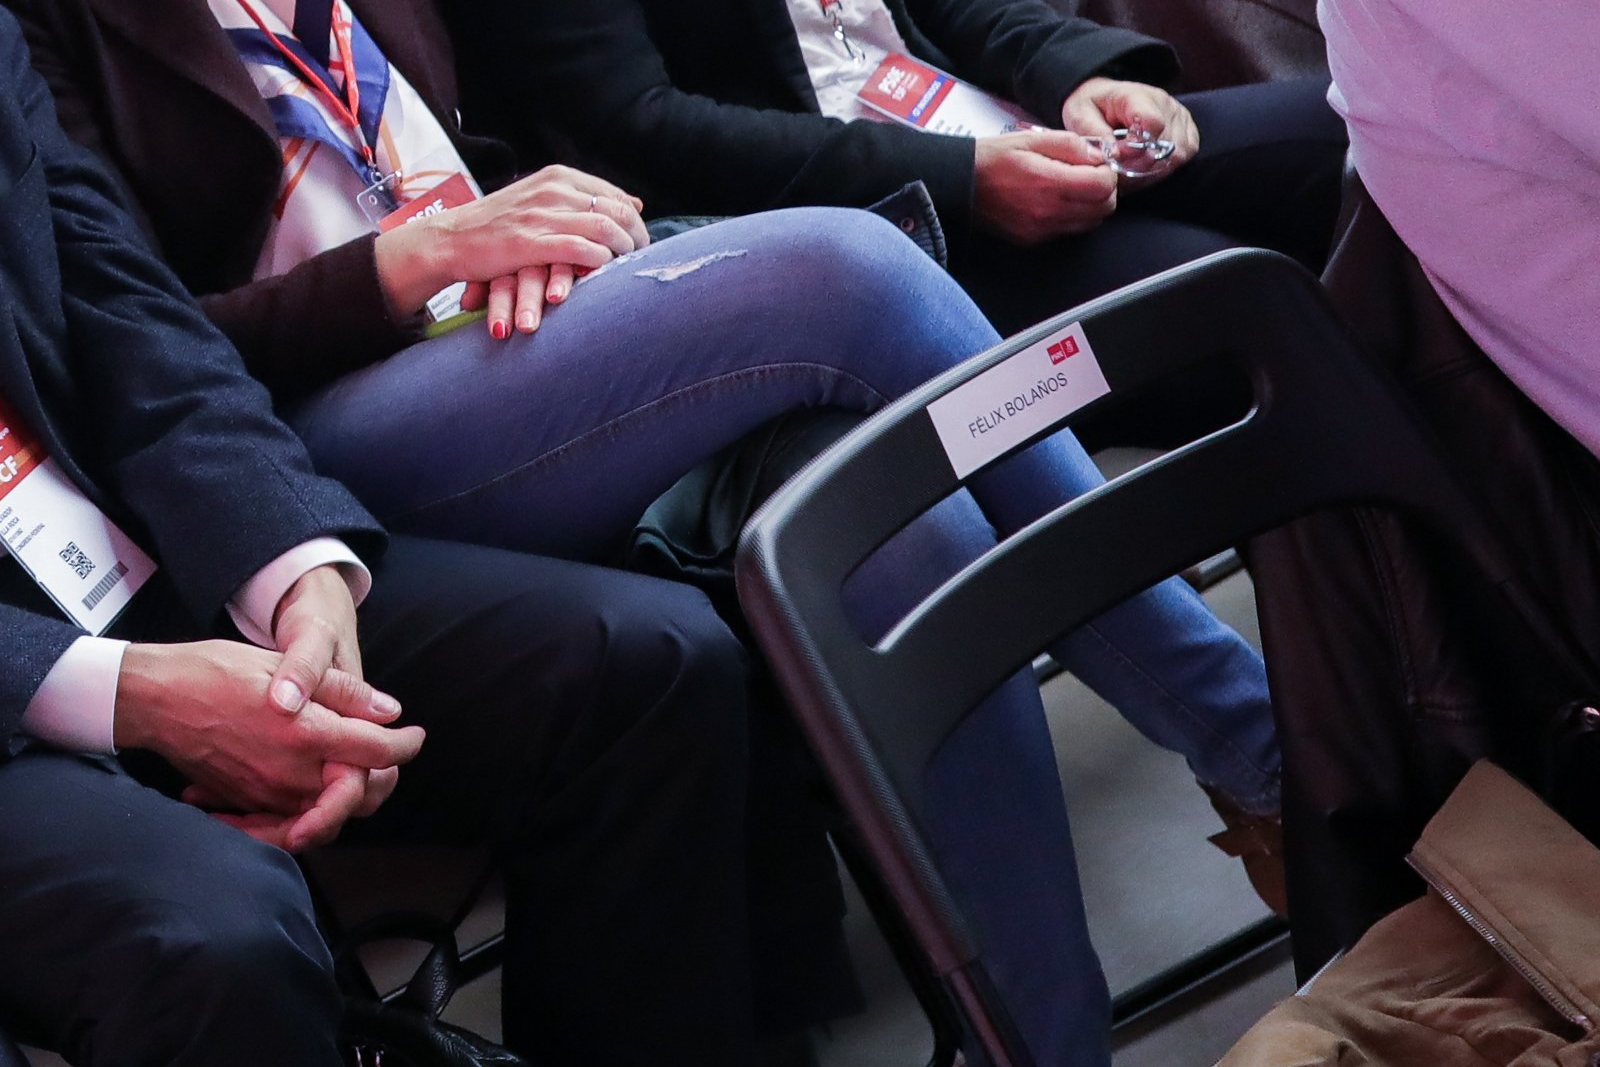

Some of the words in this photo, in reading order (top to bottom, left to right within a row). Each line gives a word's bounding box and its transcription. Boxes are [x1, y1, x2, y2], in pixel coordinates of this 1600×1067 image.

[878, 65, 905, 95] PSOE
[968, 407, 1006, 438] FÉLIX
[1004, 372, 1068, 417] BOLAÑOS
